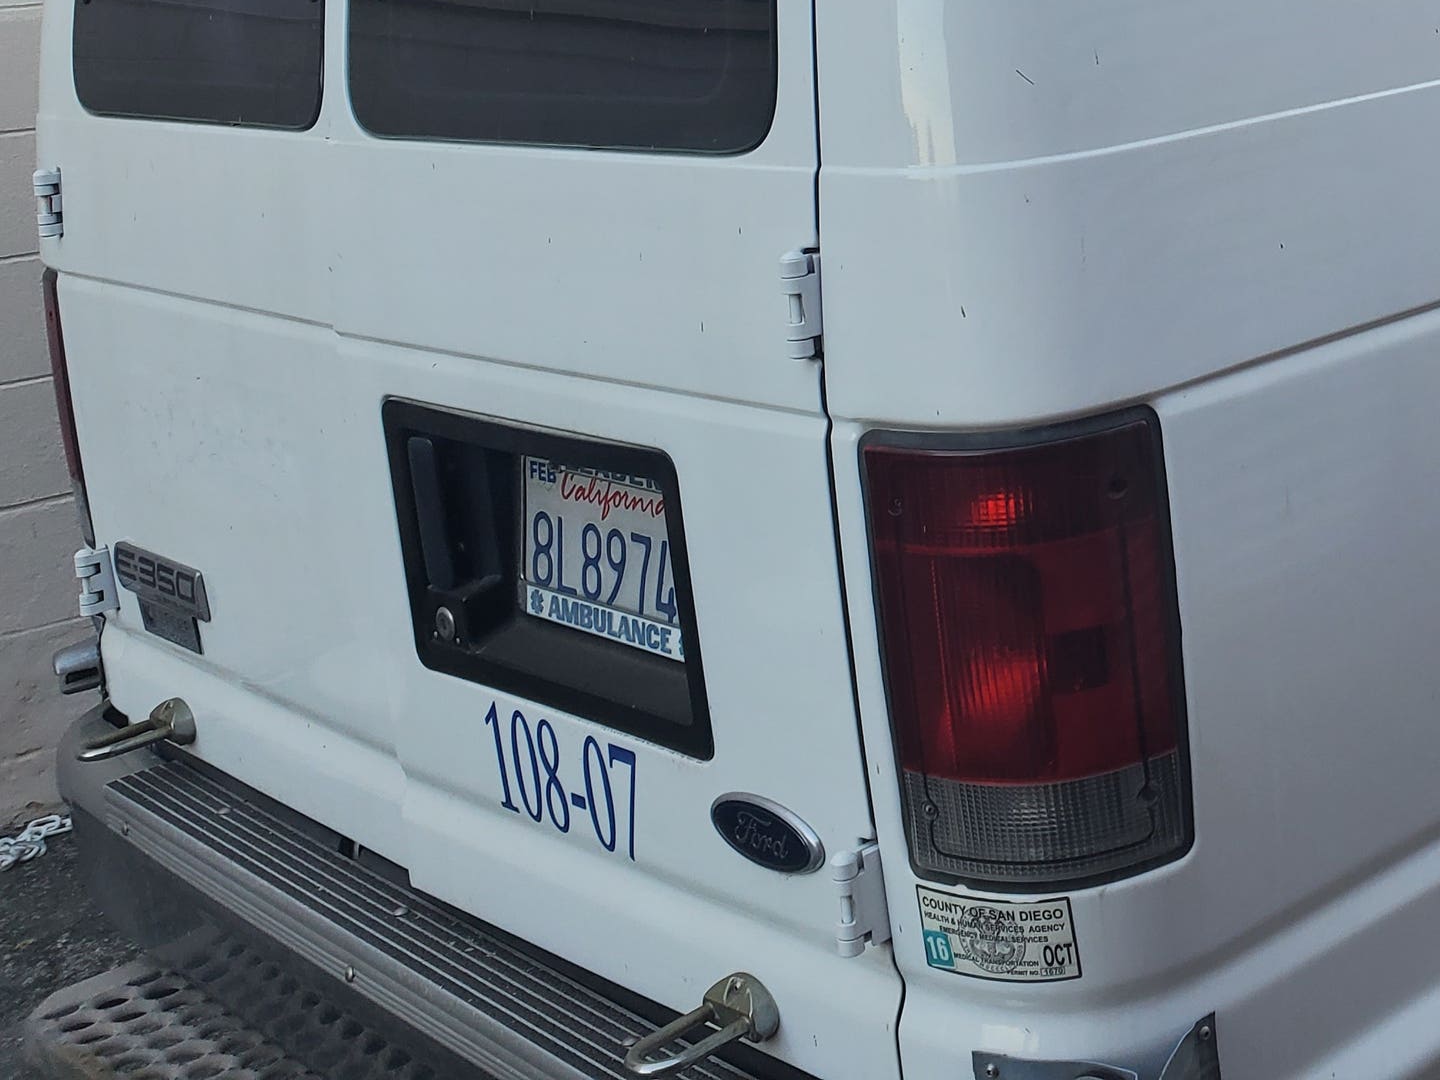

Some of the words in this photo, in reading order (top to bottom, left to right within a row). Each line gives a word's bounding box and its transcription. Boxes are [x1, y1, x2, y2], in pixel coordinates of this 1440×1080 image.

[560, 470, 665, 521] California
[549, 595, 672, 655] AMBULANCE
[485, 700, 637, 862] 108-07
[734, 810, 789, 860] Ford
[922, 895, 966, 916] COUNTY
[969, 907, 985, 918] OF
[989, 909, 1015, 921] SAN
[1019, 908, 1064, 922] DIEGO
[924, 911, 950, 924] HEALTH
[1029, 923, 1065, 933] AGENCY
[927, 936, 949, 961] 16
[1043, 943, 1073, 967] OCT
